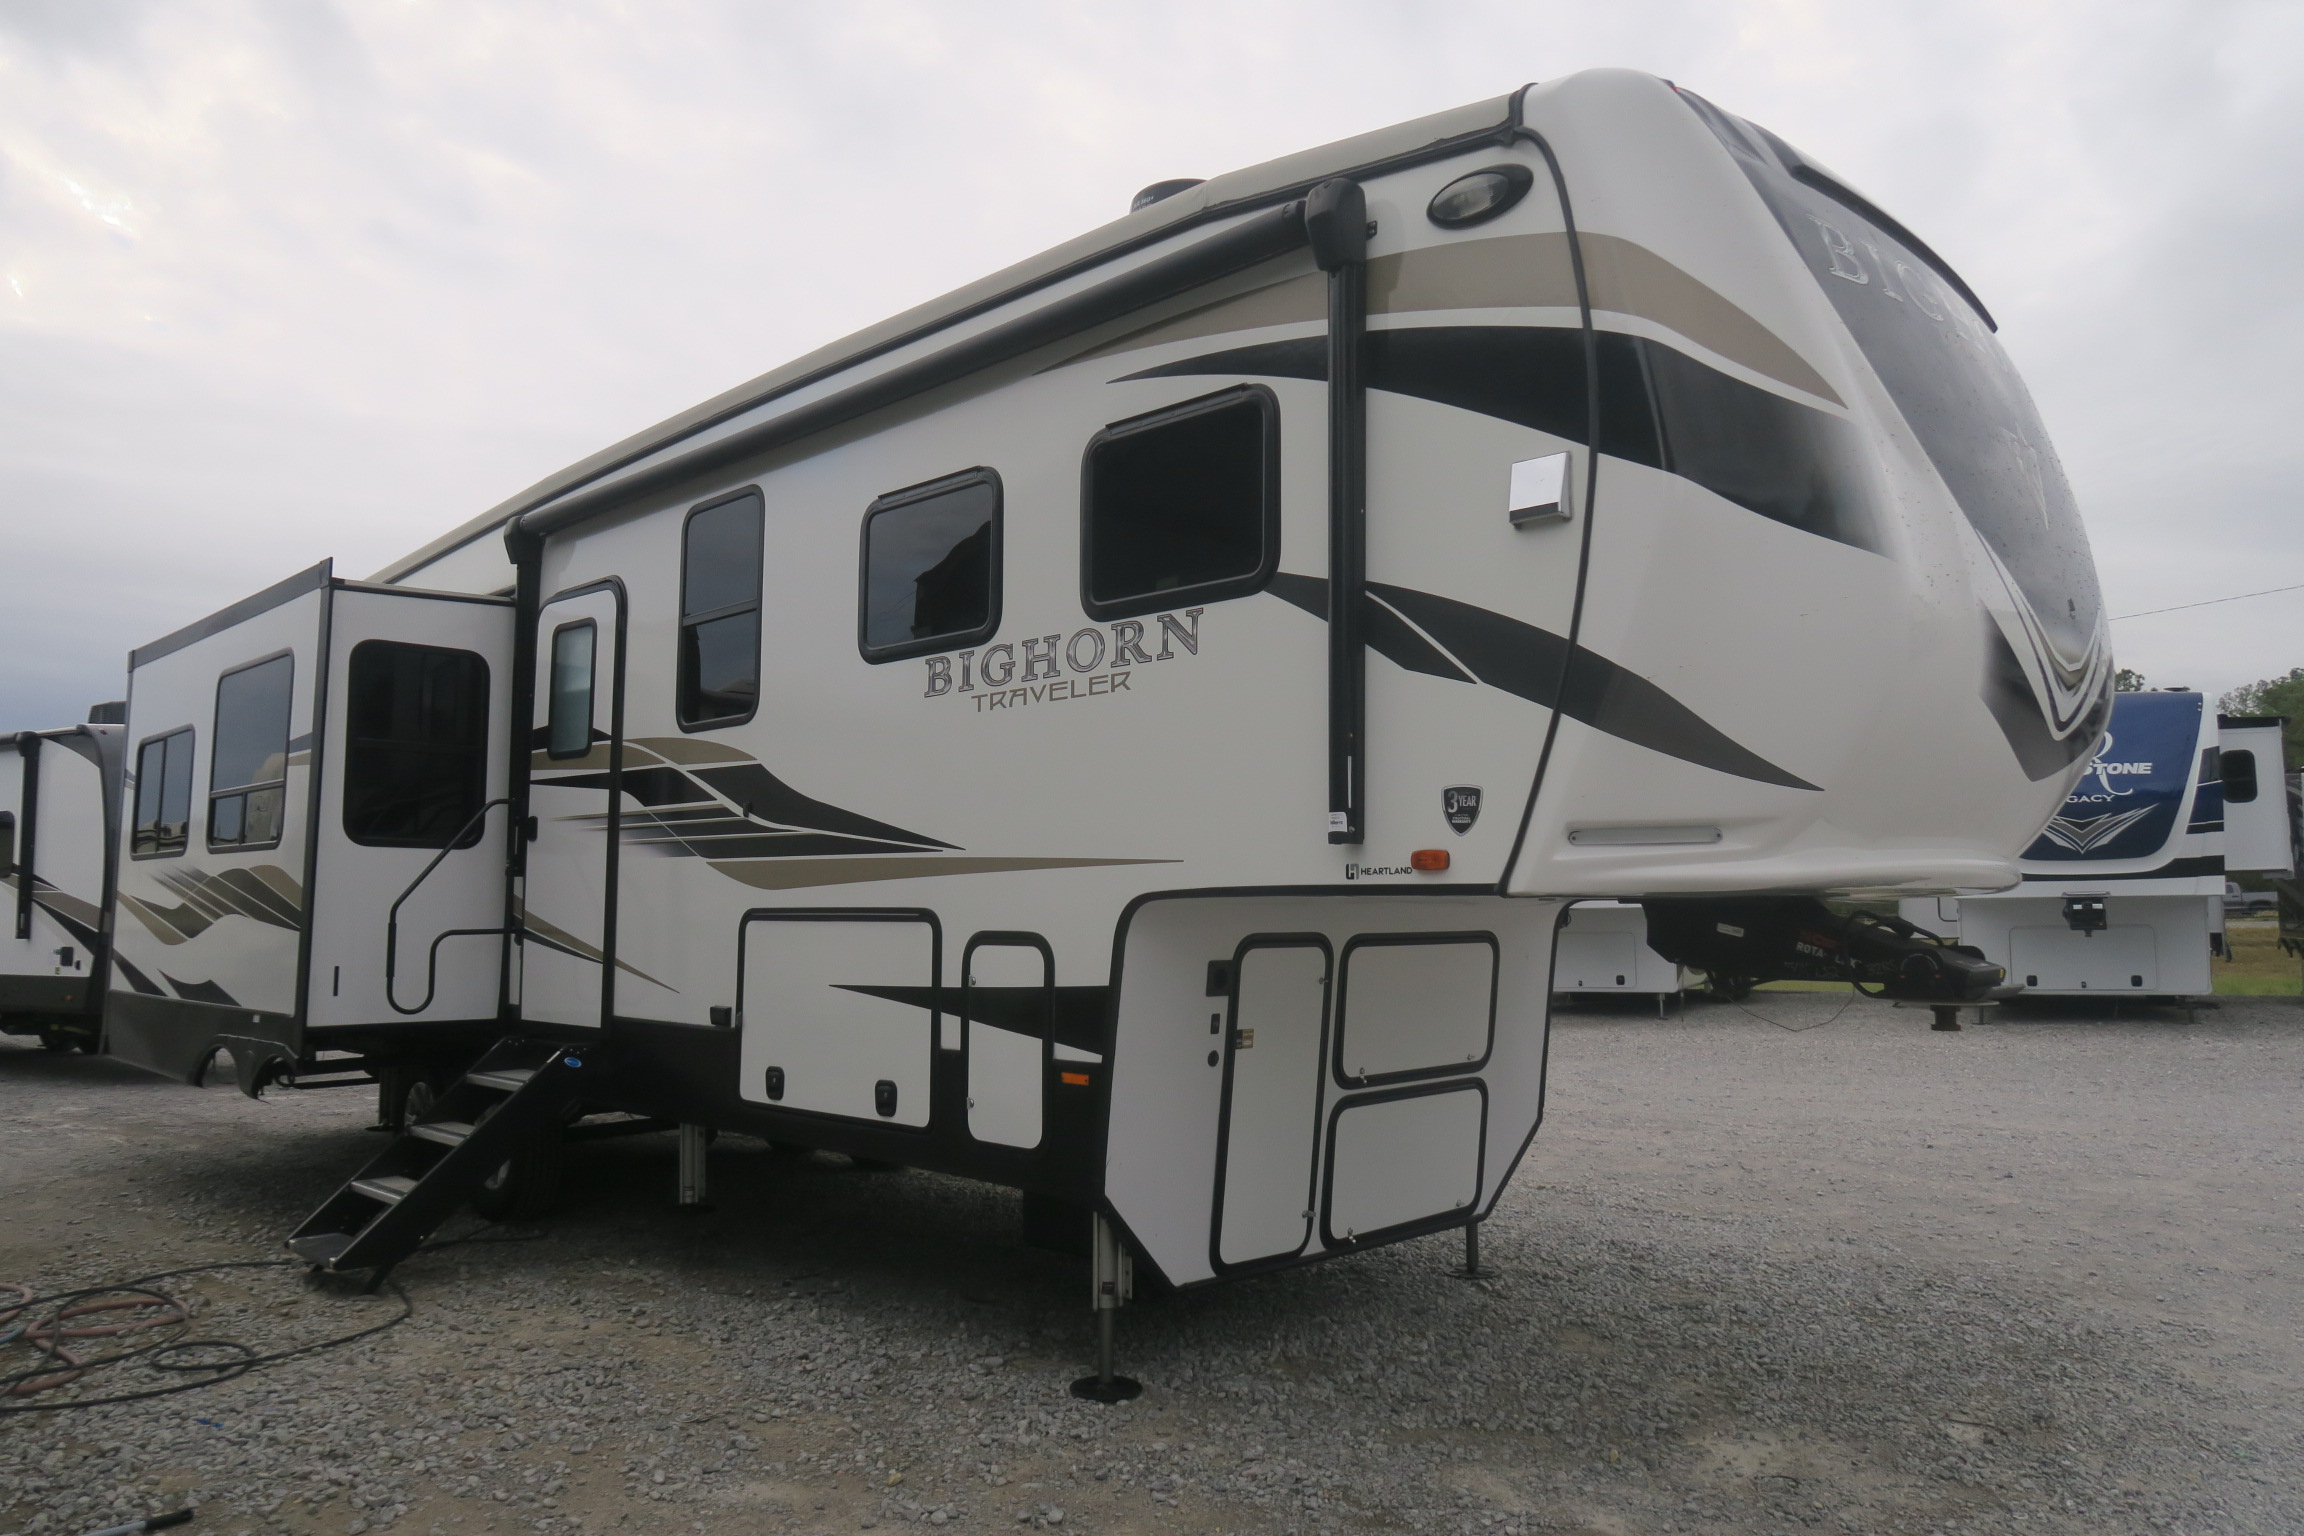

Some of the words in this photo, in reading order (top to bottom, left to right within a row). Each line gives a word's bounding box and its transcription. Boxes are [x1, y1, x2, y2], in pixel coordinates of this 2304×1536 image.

[924, 607, 1203, 698] BIGHORN
[970, 671, 1131, 712] TRAVELER
[1447, 790, 1458, 813] 3
[1458, 796, 1476, 806] YEAR
[2066, 794, 2116, 803] GACY
[1360, 866, 1413, 876] HEARTLAND
